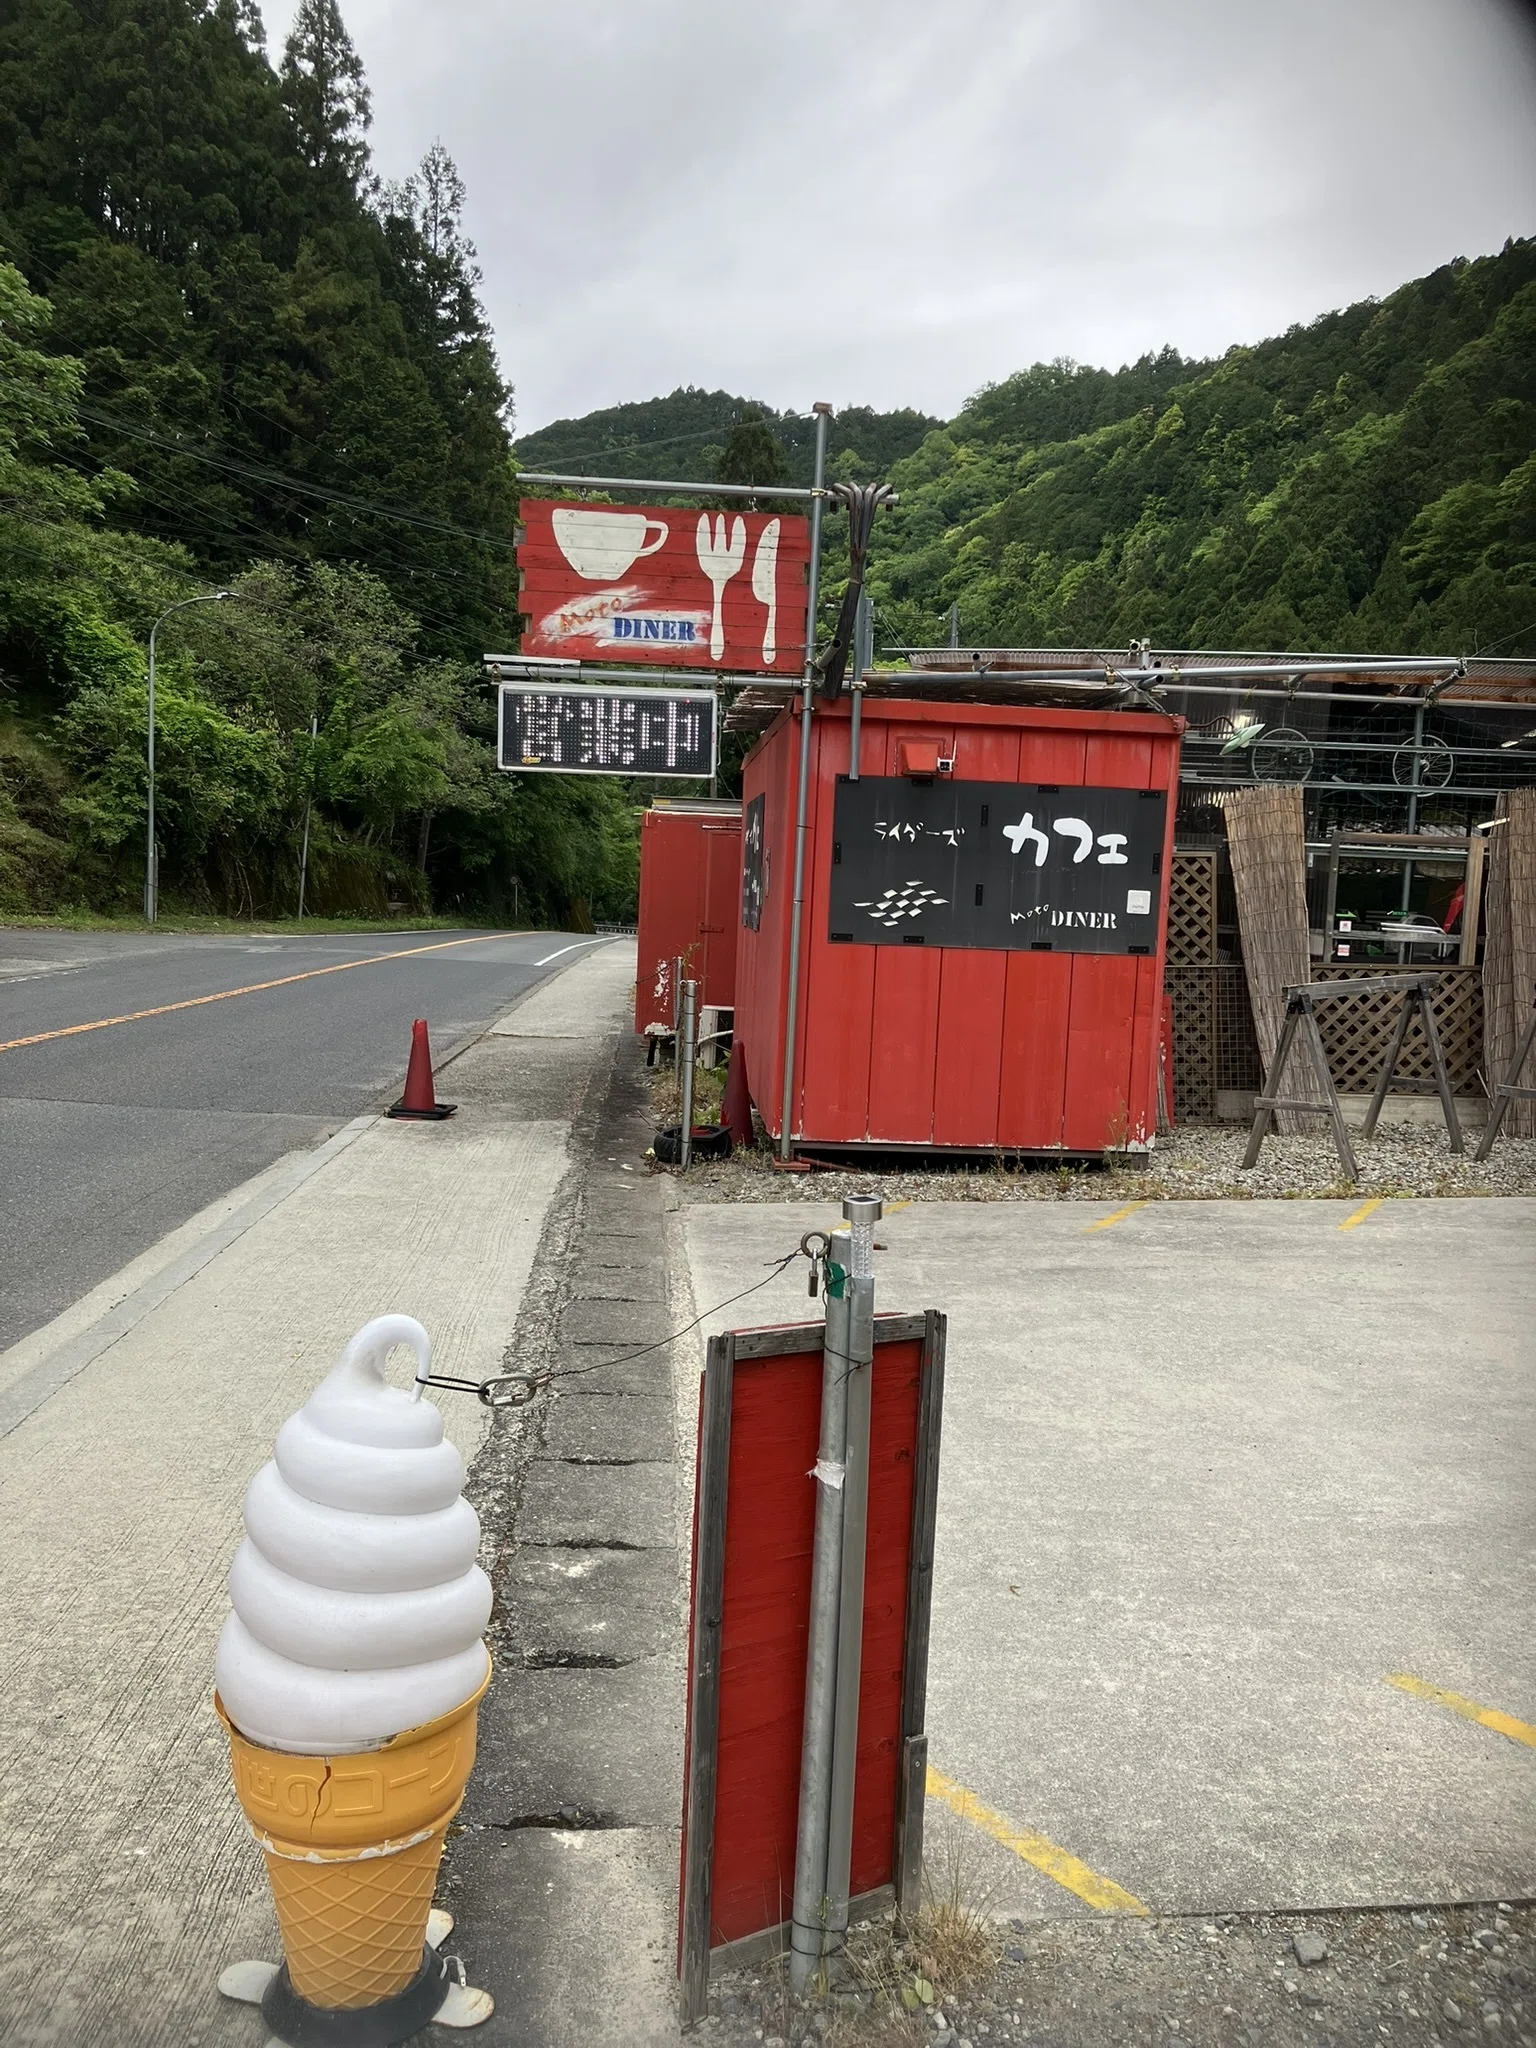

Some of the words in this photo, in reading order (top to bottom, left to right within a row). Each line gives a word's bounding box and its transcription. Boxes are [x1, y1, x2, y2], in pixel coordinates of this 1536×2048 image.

[613, 617, 696, 641] DINER
[516, 694, 700, 767] 営業中
[874, 822, 966, 847] ライダーズ
[1002, 812, 1128, 867] カフェ
[1010, 904, 1050, 925] Moto
[1051, 910, 1118, 929] DINER
